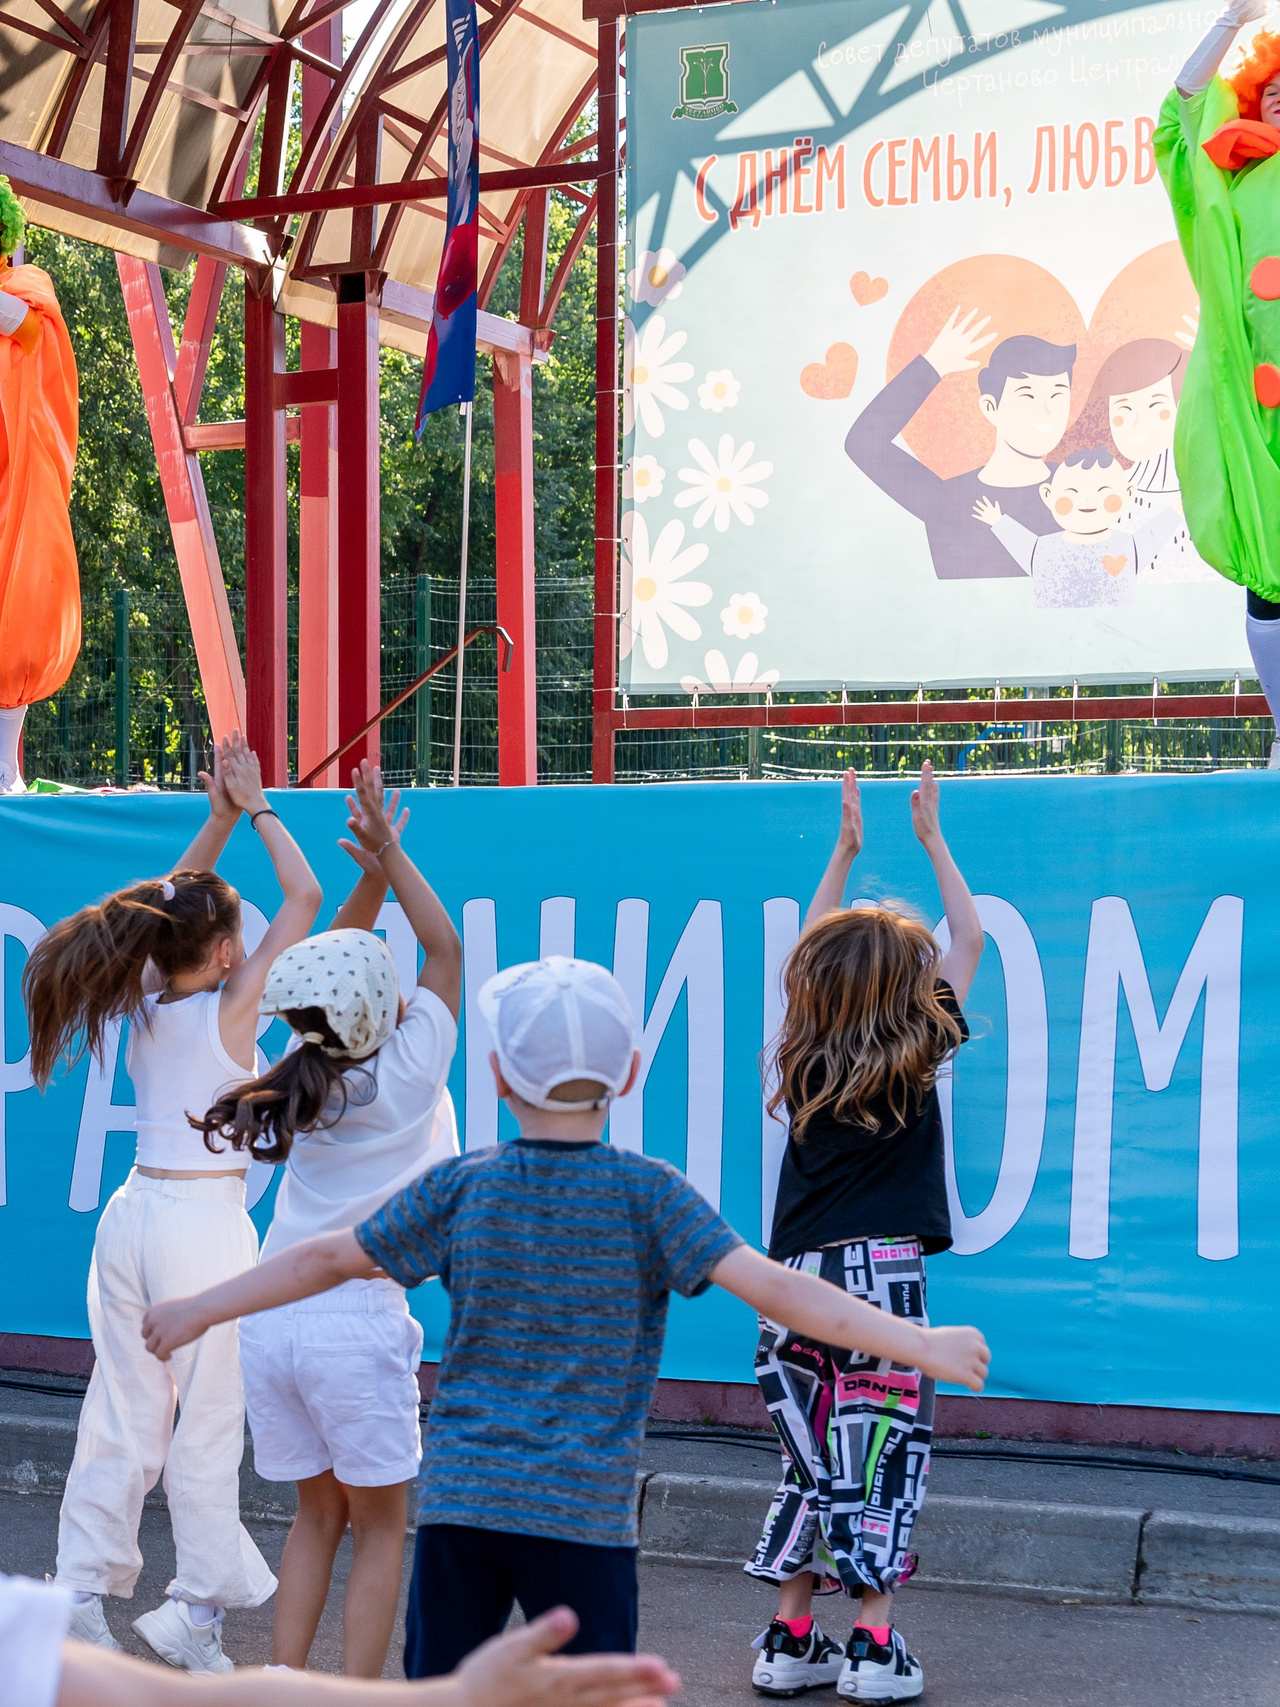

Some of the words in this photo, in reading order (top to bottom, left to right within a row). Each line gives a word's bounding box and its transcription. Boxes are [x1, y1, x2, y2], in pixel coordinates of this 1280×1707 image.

[818, 41, 884, 68] Совет
[894, 30, 1022, 67] депутатов
[1033, 9, 1219, 57] муниципально
[923, 67, 1058, 108] Чертаново
[696, 155, 718, 221] С
[730, 137, 846, 230] ДНЁМ
[863, 131, 1012, 208] СЕМЬИ,
[1026, 116, 1157, 194] ЛЮБВ
[843, 1378, 919, 1399] DANCE
[870, 1431, 904, 1507] DIGITAL
